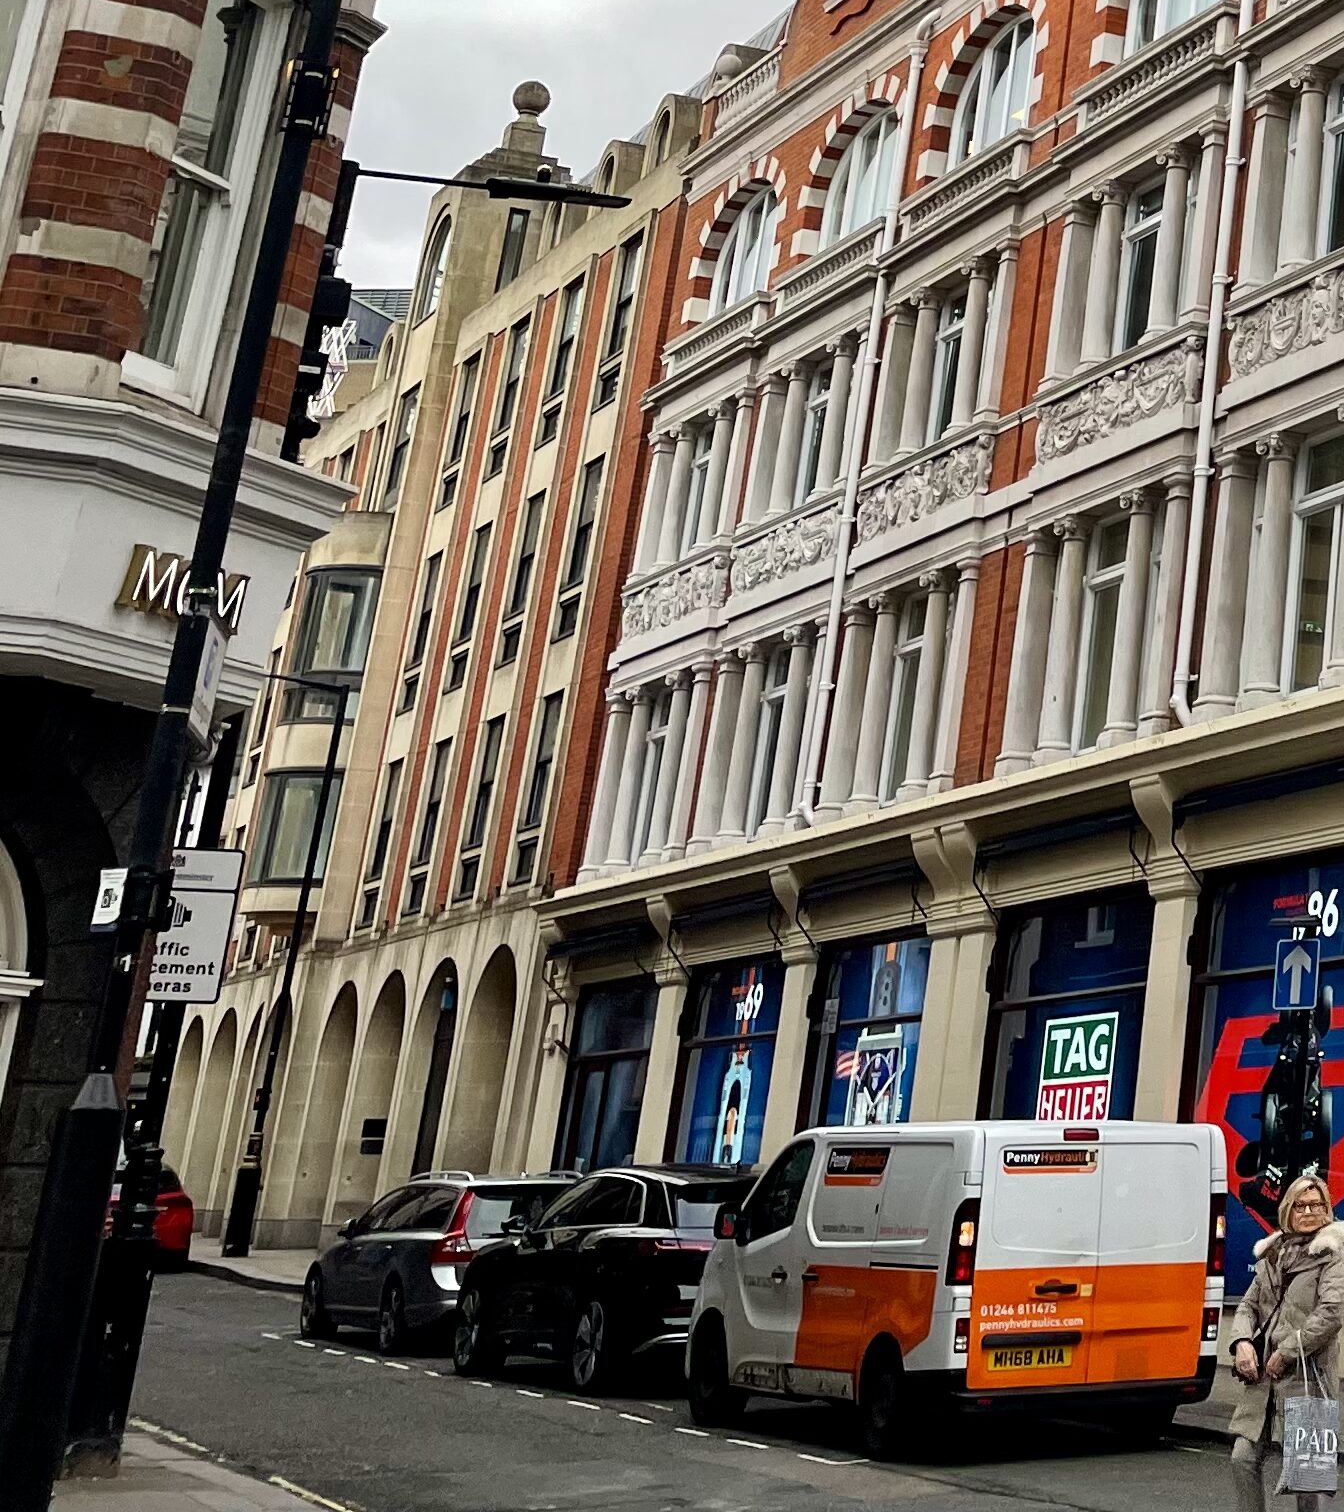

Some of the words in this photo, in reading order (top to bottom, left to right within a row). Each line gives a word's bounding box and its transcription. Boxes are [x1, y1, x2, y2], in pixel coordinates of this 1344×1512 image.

[154, 942, 190, 956] ffic
[151, 961, 215, 976] cement
[150, 981, 192, 993] eras
[1051, 1023, 1110, 1074] TAG
[980, 1304, 1015, 1317] 01246
[980, 1317, 1084, 1333] pennyhydraulics.com
[993, 1350, 1033, 1368] MH68
[1037, 1348, 1065, 1366] AHA
[1295, 1427, 1338, 1454] PAD
